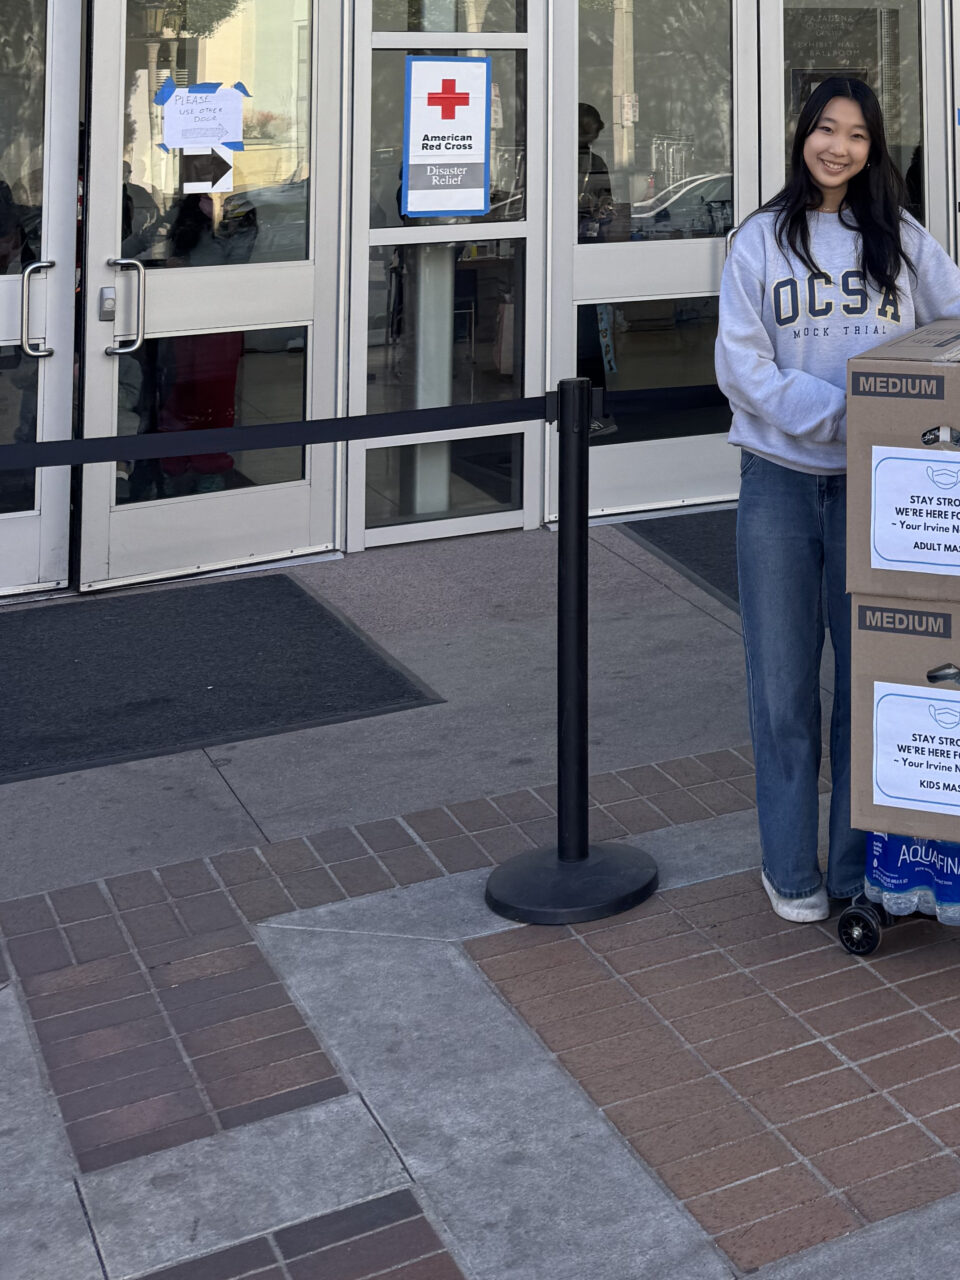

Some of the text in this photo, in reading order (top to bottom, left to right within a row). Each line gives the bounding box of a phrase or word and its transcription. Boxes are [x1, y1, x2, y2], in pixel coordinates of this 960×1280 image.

[174, 94, 212, 106] PLEASE
[422, 134, 472, 142] American
[421, 142, 473, 150] Red Cross
[426, 166, 468, 176] Disaster
[432, 176, 463, 186] Relief
[772, 269, 901, 328] OCSA
[793, 326, 887, 339] MOCK TRIAL
[859, 376, 937, 395] MEDIUM
[910, 495, 934, 506] STAY
[895, 507, 924, 518] WE'RE
[926, 509, 948, 520] HERE
[900, 520, 922, 530] Your
[924, 522, 950, 532] Irvine
[913, 541, 942, 552] ADULT
[866, 610, 944, 632] MEDIUM
[912, 733, 936, 744] STAY
[897, 744, 926, 756] WE'RE
[928, 748, 951, 758] HERE
[902, 757, 924, 768] Your
[926, 760, 952, 772] Irvine
[920, 780, 940, 790] KIDS
